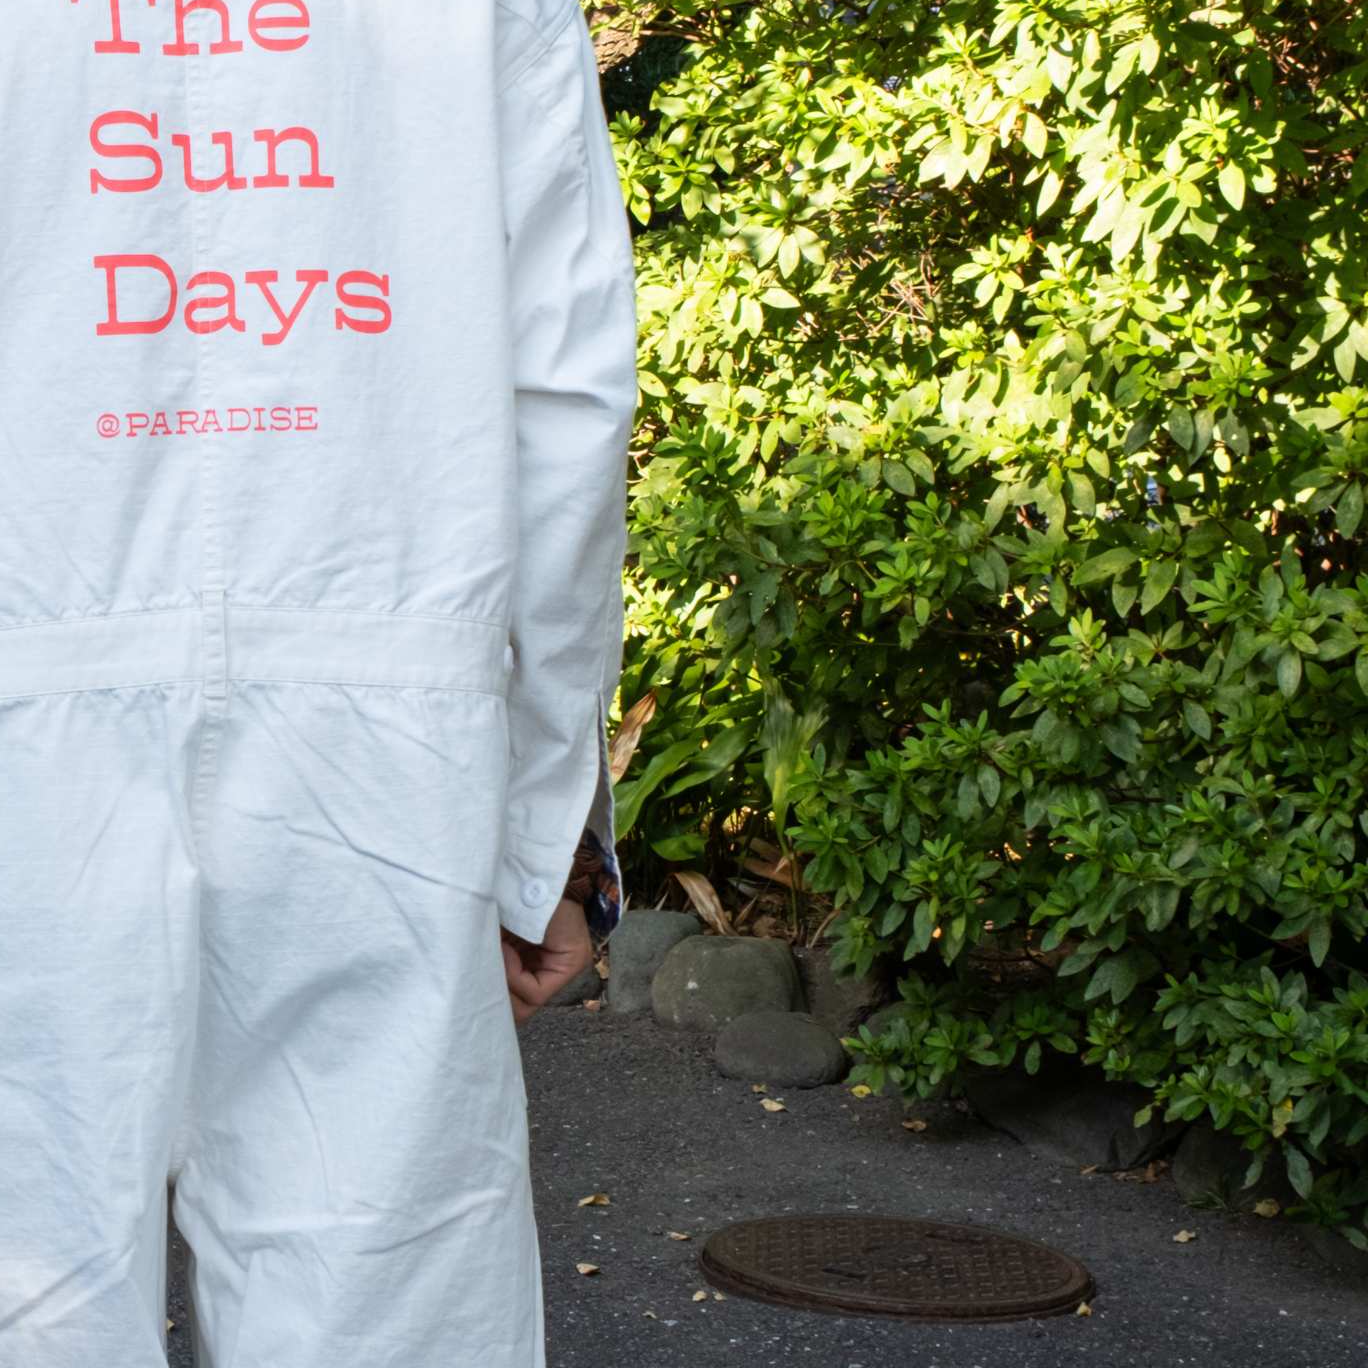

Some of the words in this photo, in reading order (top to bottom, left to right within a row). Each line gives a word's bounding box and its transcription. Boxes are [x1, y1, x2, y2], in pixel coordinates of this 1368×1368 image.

[88, 108, 336, 196] Sun
[92, 253, 393, 348] Days
[96, 406, 319, 439] @PARADISE
